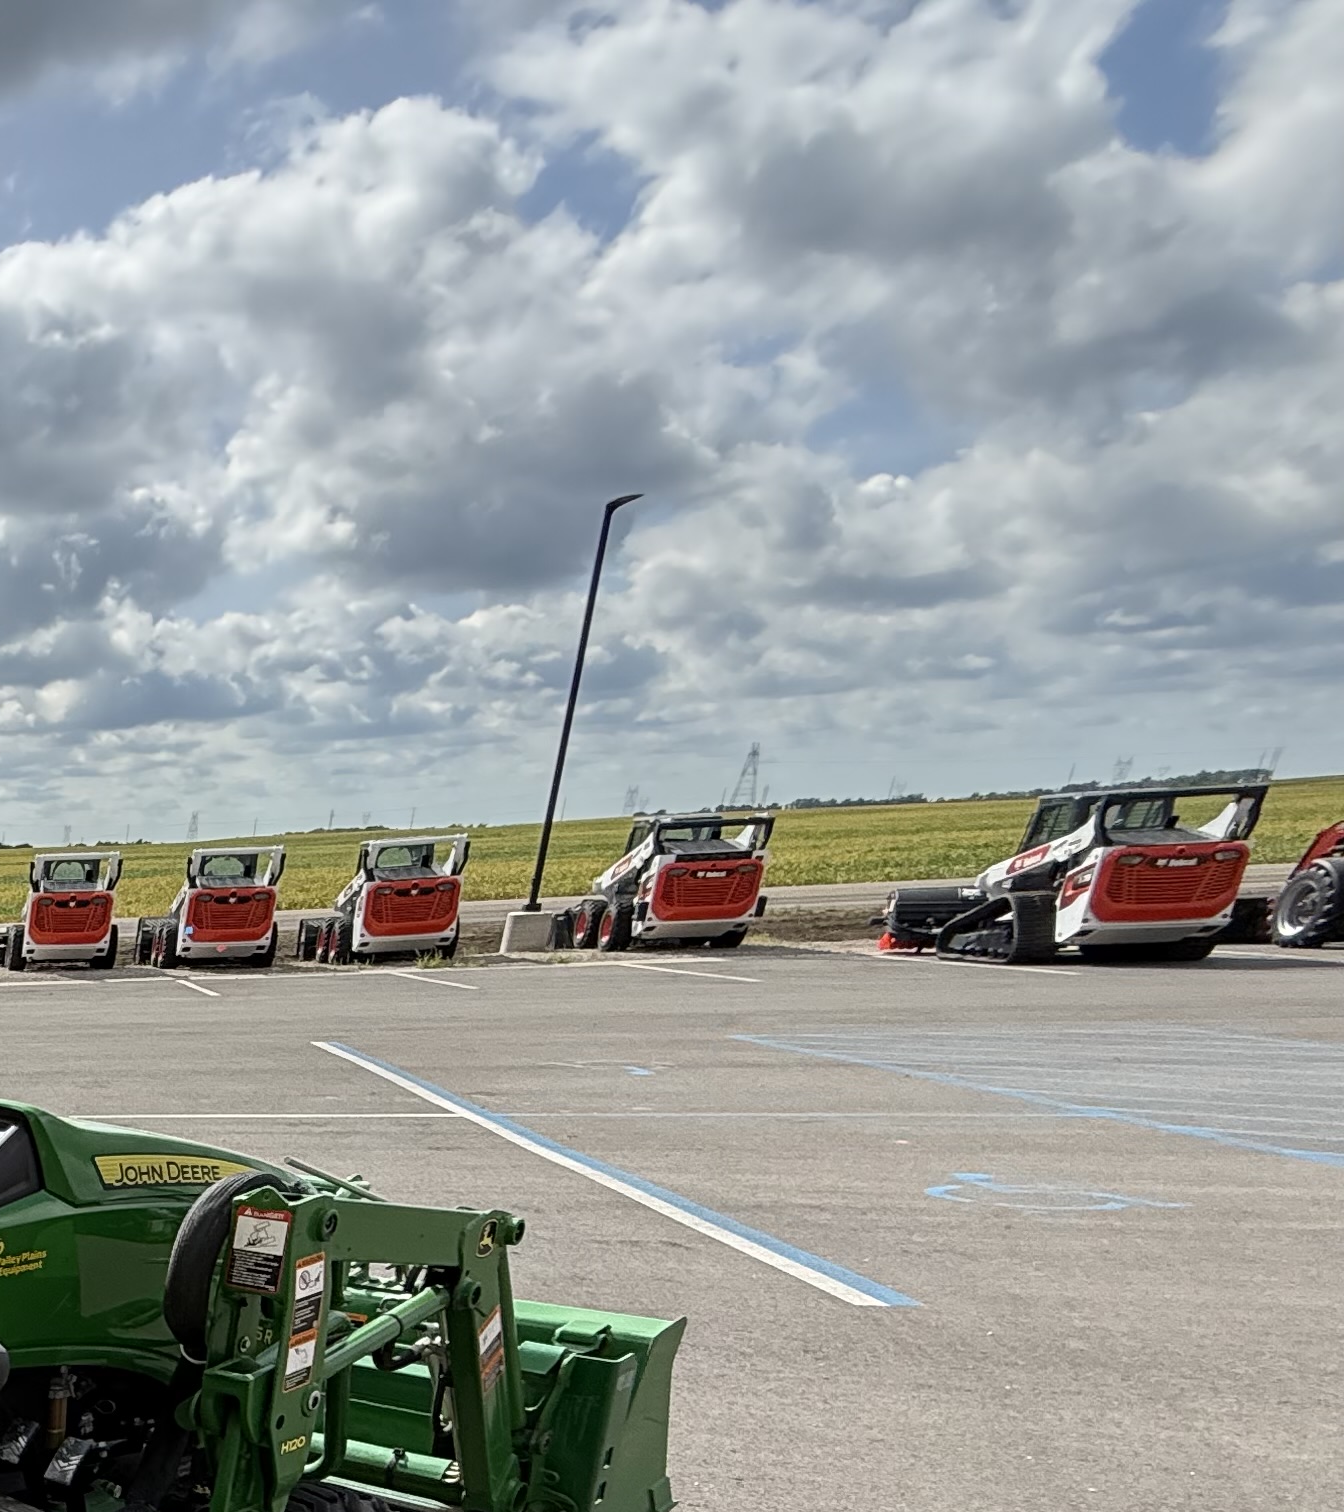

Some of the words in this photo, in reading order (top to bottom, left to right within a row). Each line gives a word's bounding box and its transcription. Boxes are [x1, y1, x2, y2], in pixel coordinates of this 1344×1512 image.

[115, 1162, 163, 1184] JOHN
[166, 1161, 221, 1182] DEERE
[280, 1435, 306, 1456] H120
